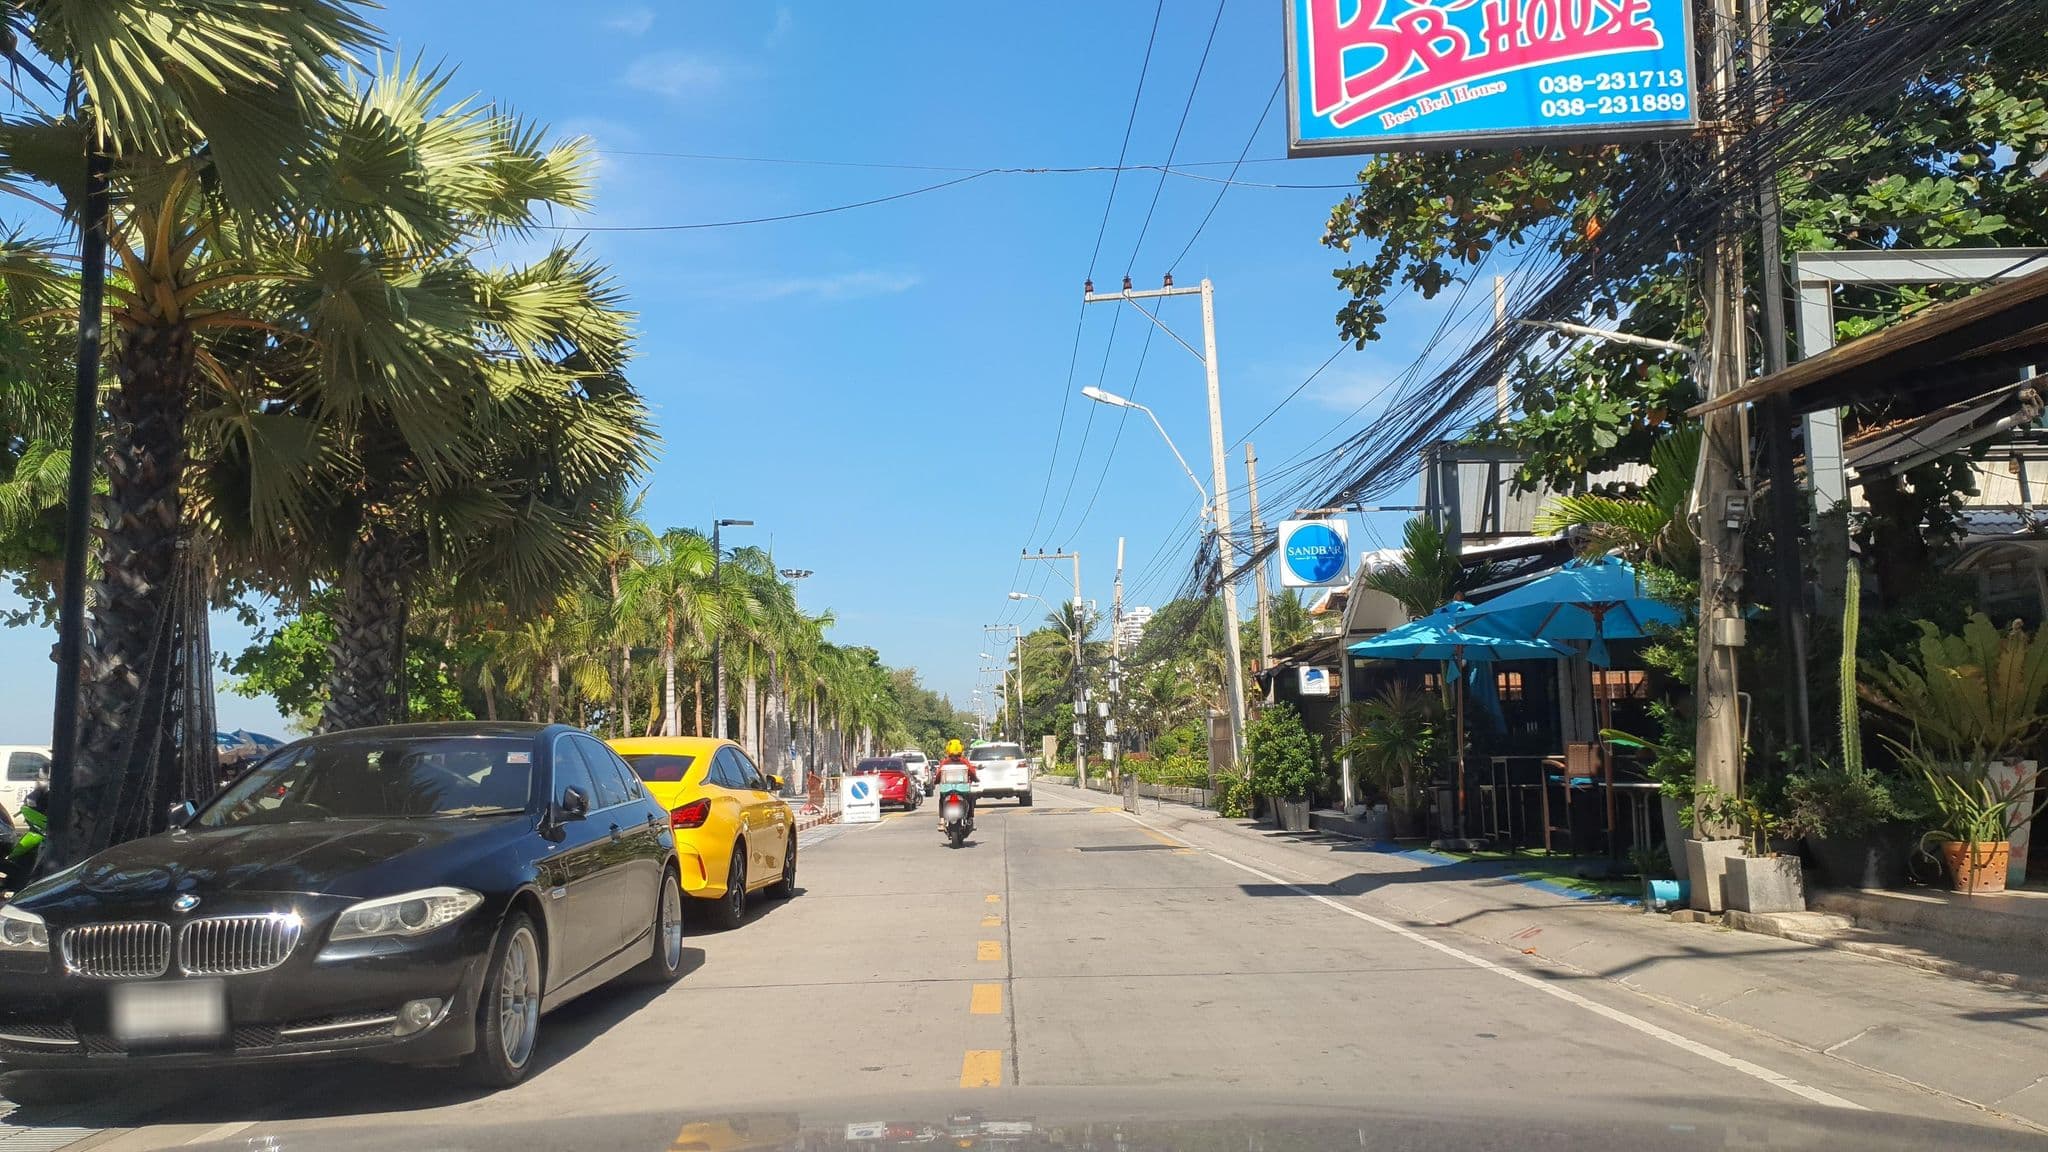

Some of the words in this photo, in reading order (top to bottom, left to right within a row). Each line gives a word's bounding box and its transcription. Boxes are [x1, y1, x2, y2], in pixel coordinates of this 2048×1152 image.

[1538, 69, 1684, 94] 038-231713
[1380, 108, 1418, 129] Best
[1418, 92, 1450, 115] Bed
[1453, 80, 1507, 105] House
[1541, 93, 1686, 117] 038-231889
